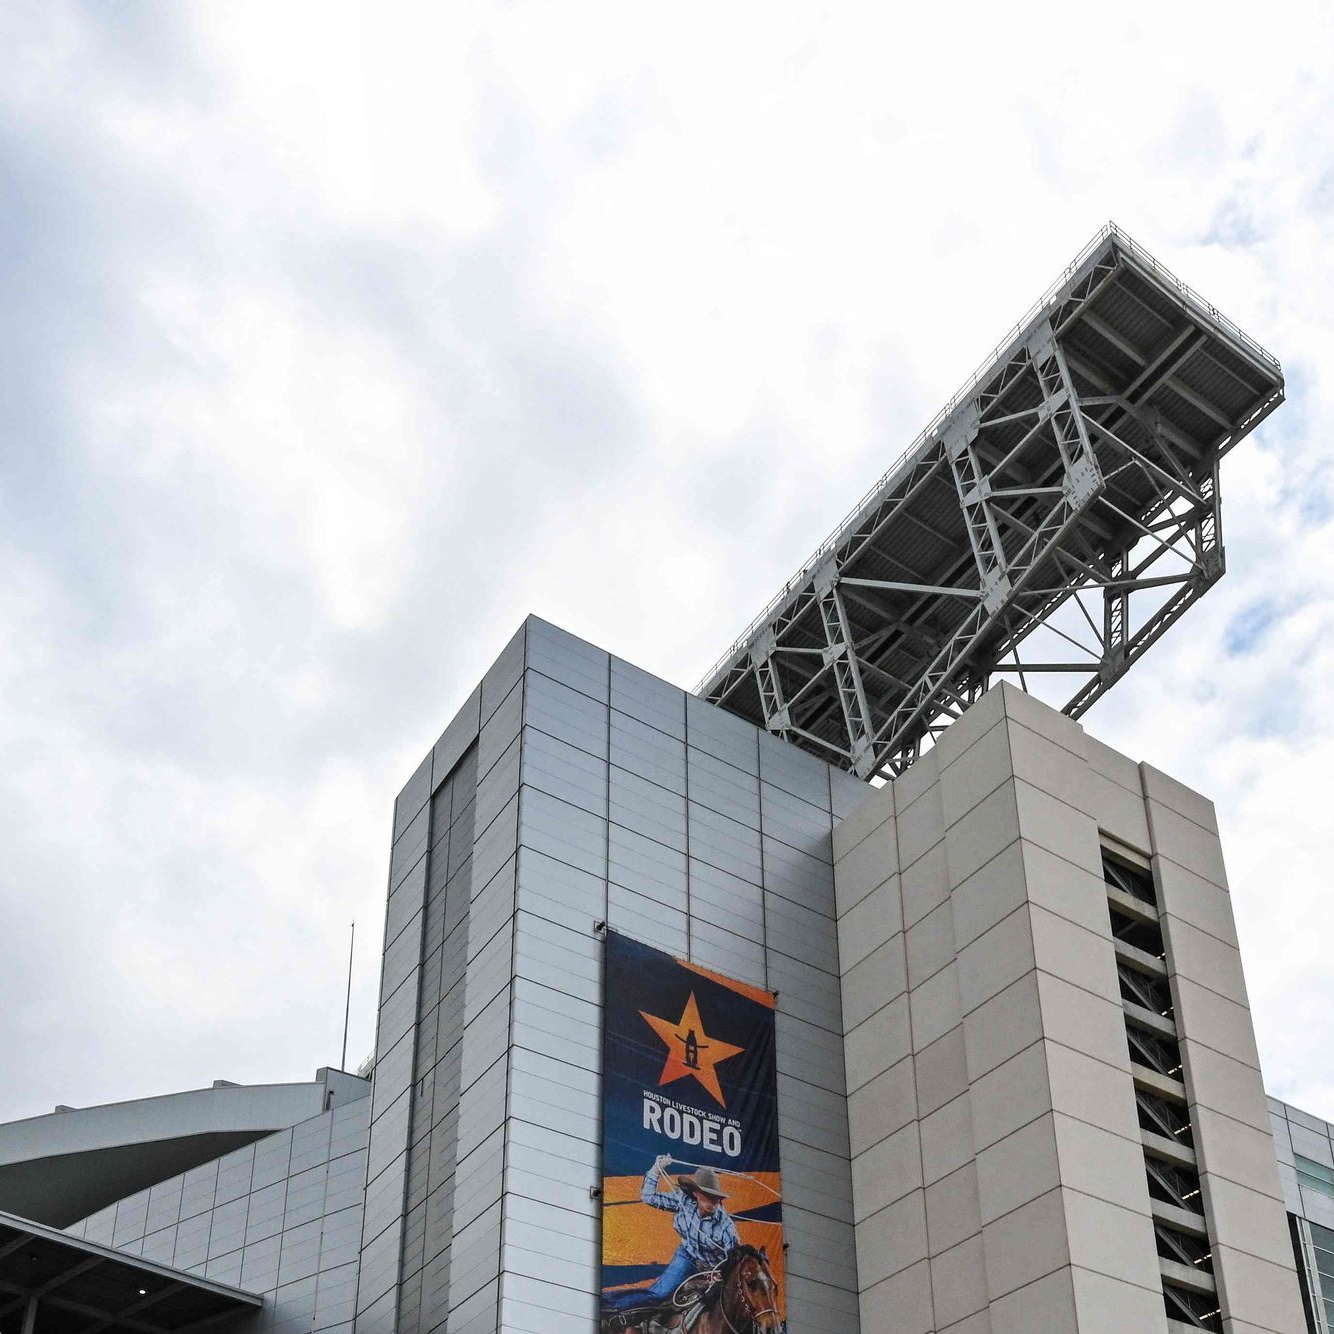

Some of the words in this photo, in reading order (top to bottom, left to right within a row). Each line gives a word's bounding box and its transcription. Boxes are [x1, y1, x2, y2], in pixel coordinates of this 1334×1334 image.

[643, 1089, 671, 1107] HOUSTON
[671, 1100, 707, 1118] LIVESTOCK
[708, 1112, 726, 1124] SHOW
[728, 1118, 741, 1128] AND
[643, 1098, 742, 1157] RODEO
